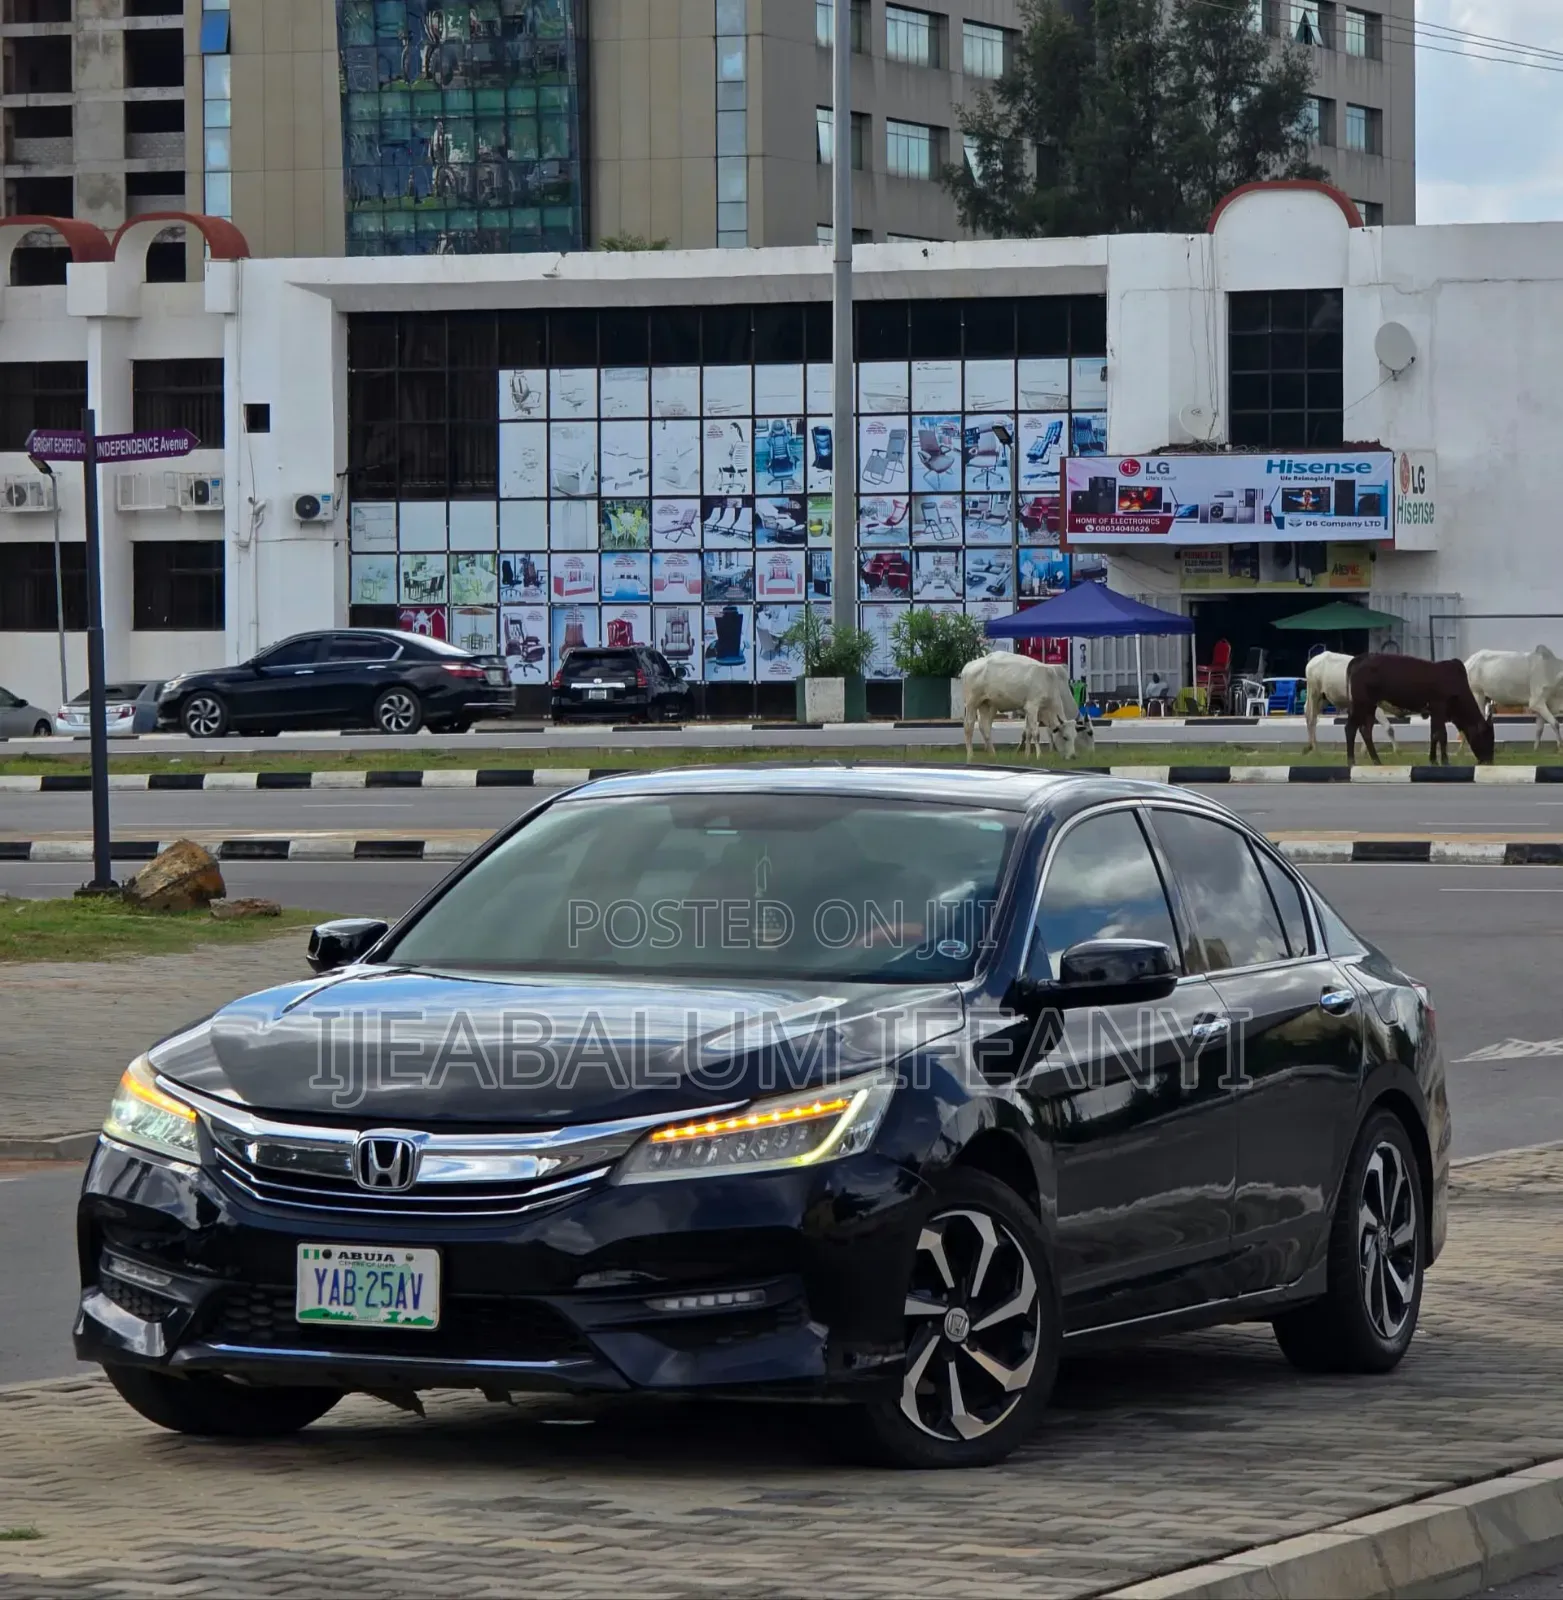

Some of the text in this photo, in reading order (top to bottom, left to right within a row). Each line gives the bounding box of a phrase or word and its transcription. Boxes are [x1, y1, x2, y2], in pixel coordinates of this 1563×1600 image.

[33, 436, 54, 453] BRIGHT
[96, 436, 189, 457] INDEPENDENCE Avenue
[1145, 461, 1170, 474] LG
[1266, 459, 1372, 474] Hisense
[1411, 465, 1426, 495] LG
[1396, 494, 1435, 525] Hisense
[1110, 517, 1160, 525] ELECTRONICS
[1320, 520, 1363, 528] Company
[337, 1251, 395, 1263] ABUJA
[314, 1267, 424, 1310] YAB-25AV
